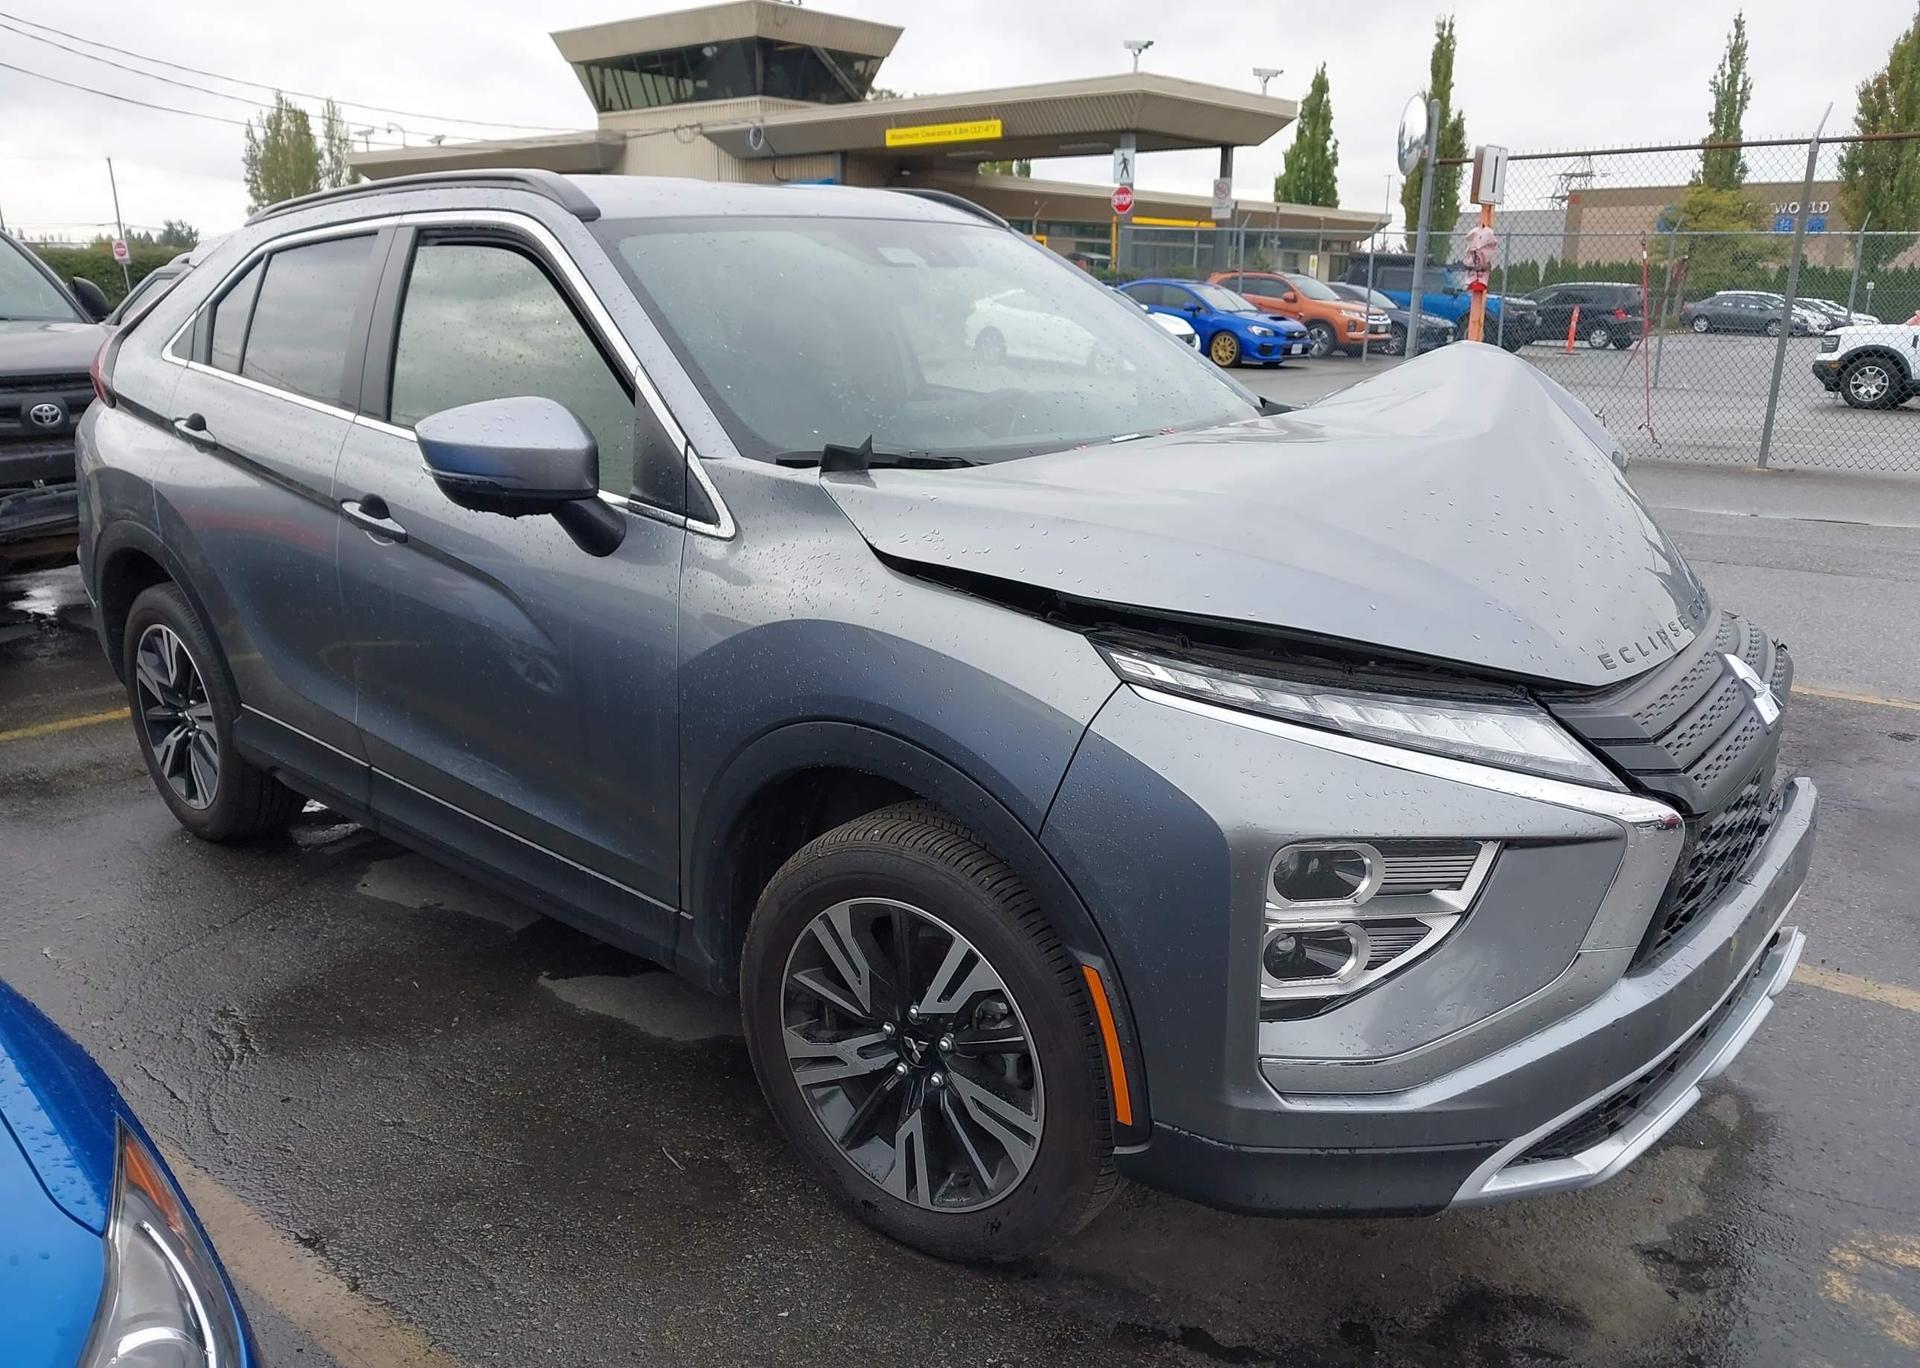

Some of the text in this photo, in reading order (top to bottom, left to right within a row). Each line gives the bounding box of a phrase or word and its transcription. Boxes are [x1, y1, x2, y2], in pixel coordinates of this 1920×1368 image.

[1112, 194, 1133, 205] STOP
[1774, 201, 1830, 214] WOLD
[1597, 614, 1689, 671] ECLIPSE
